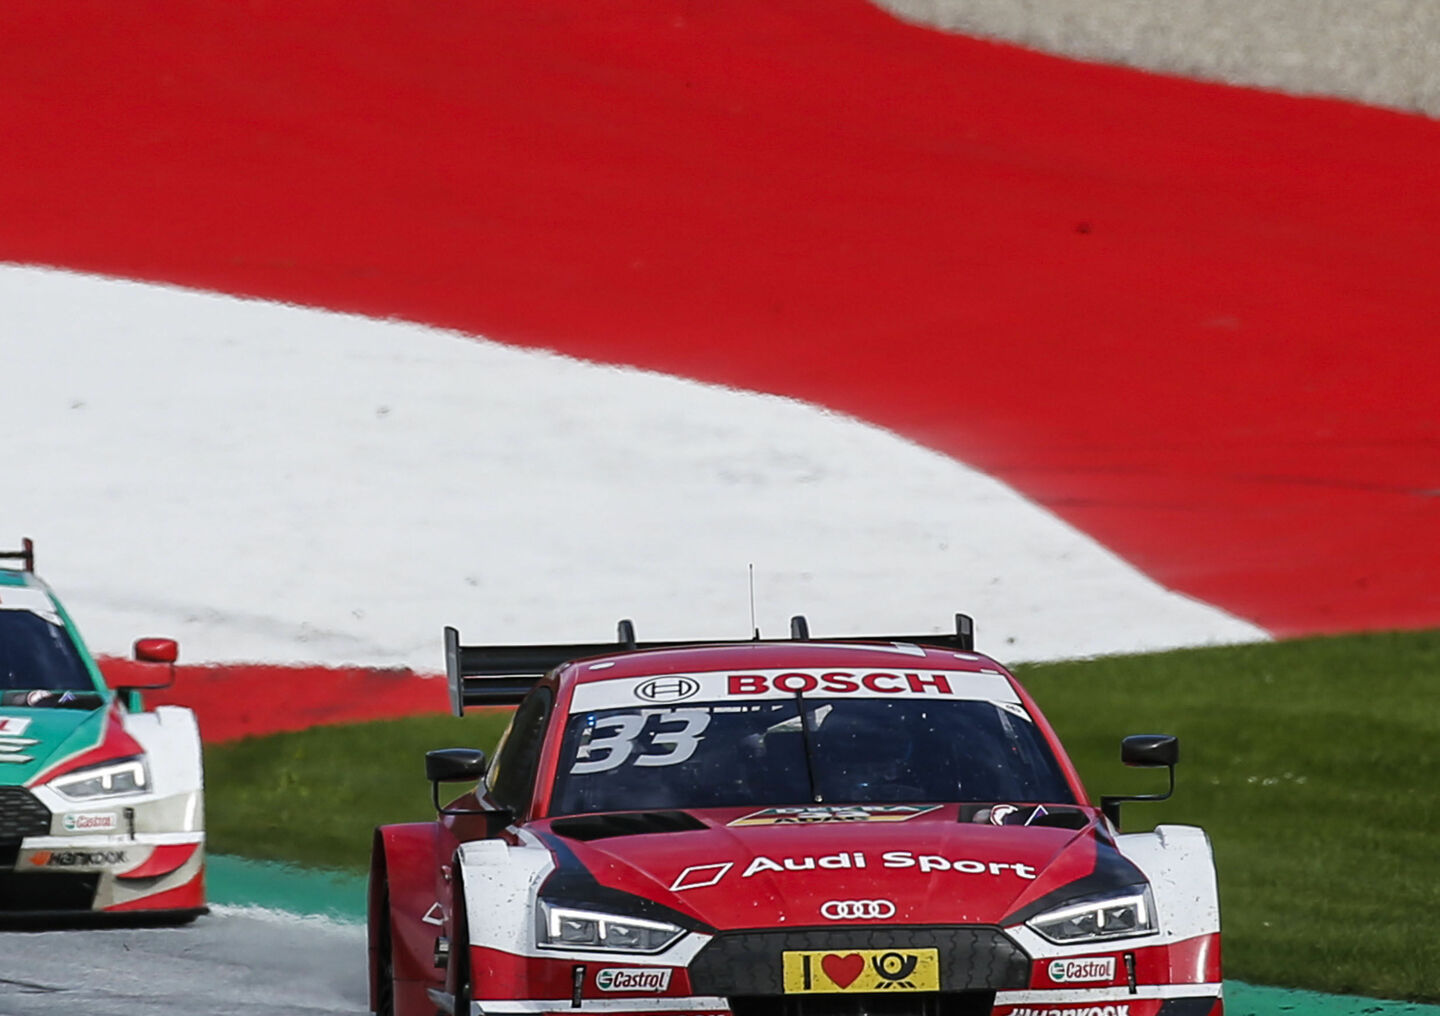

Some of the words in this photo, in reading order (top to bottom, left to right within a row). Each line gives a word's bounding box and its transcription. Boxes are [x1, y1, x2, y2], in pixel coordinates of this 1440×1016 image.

[727, 672, 954, 695] BOSCH
[569, 708, 711, 776] 33
[741, 851, 868, 878] Audi
[881, 851, 1038, 881] Sport
[613, 970, 667, 989] Castrol
[1066, 959, 1112, 980] Castrol
